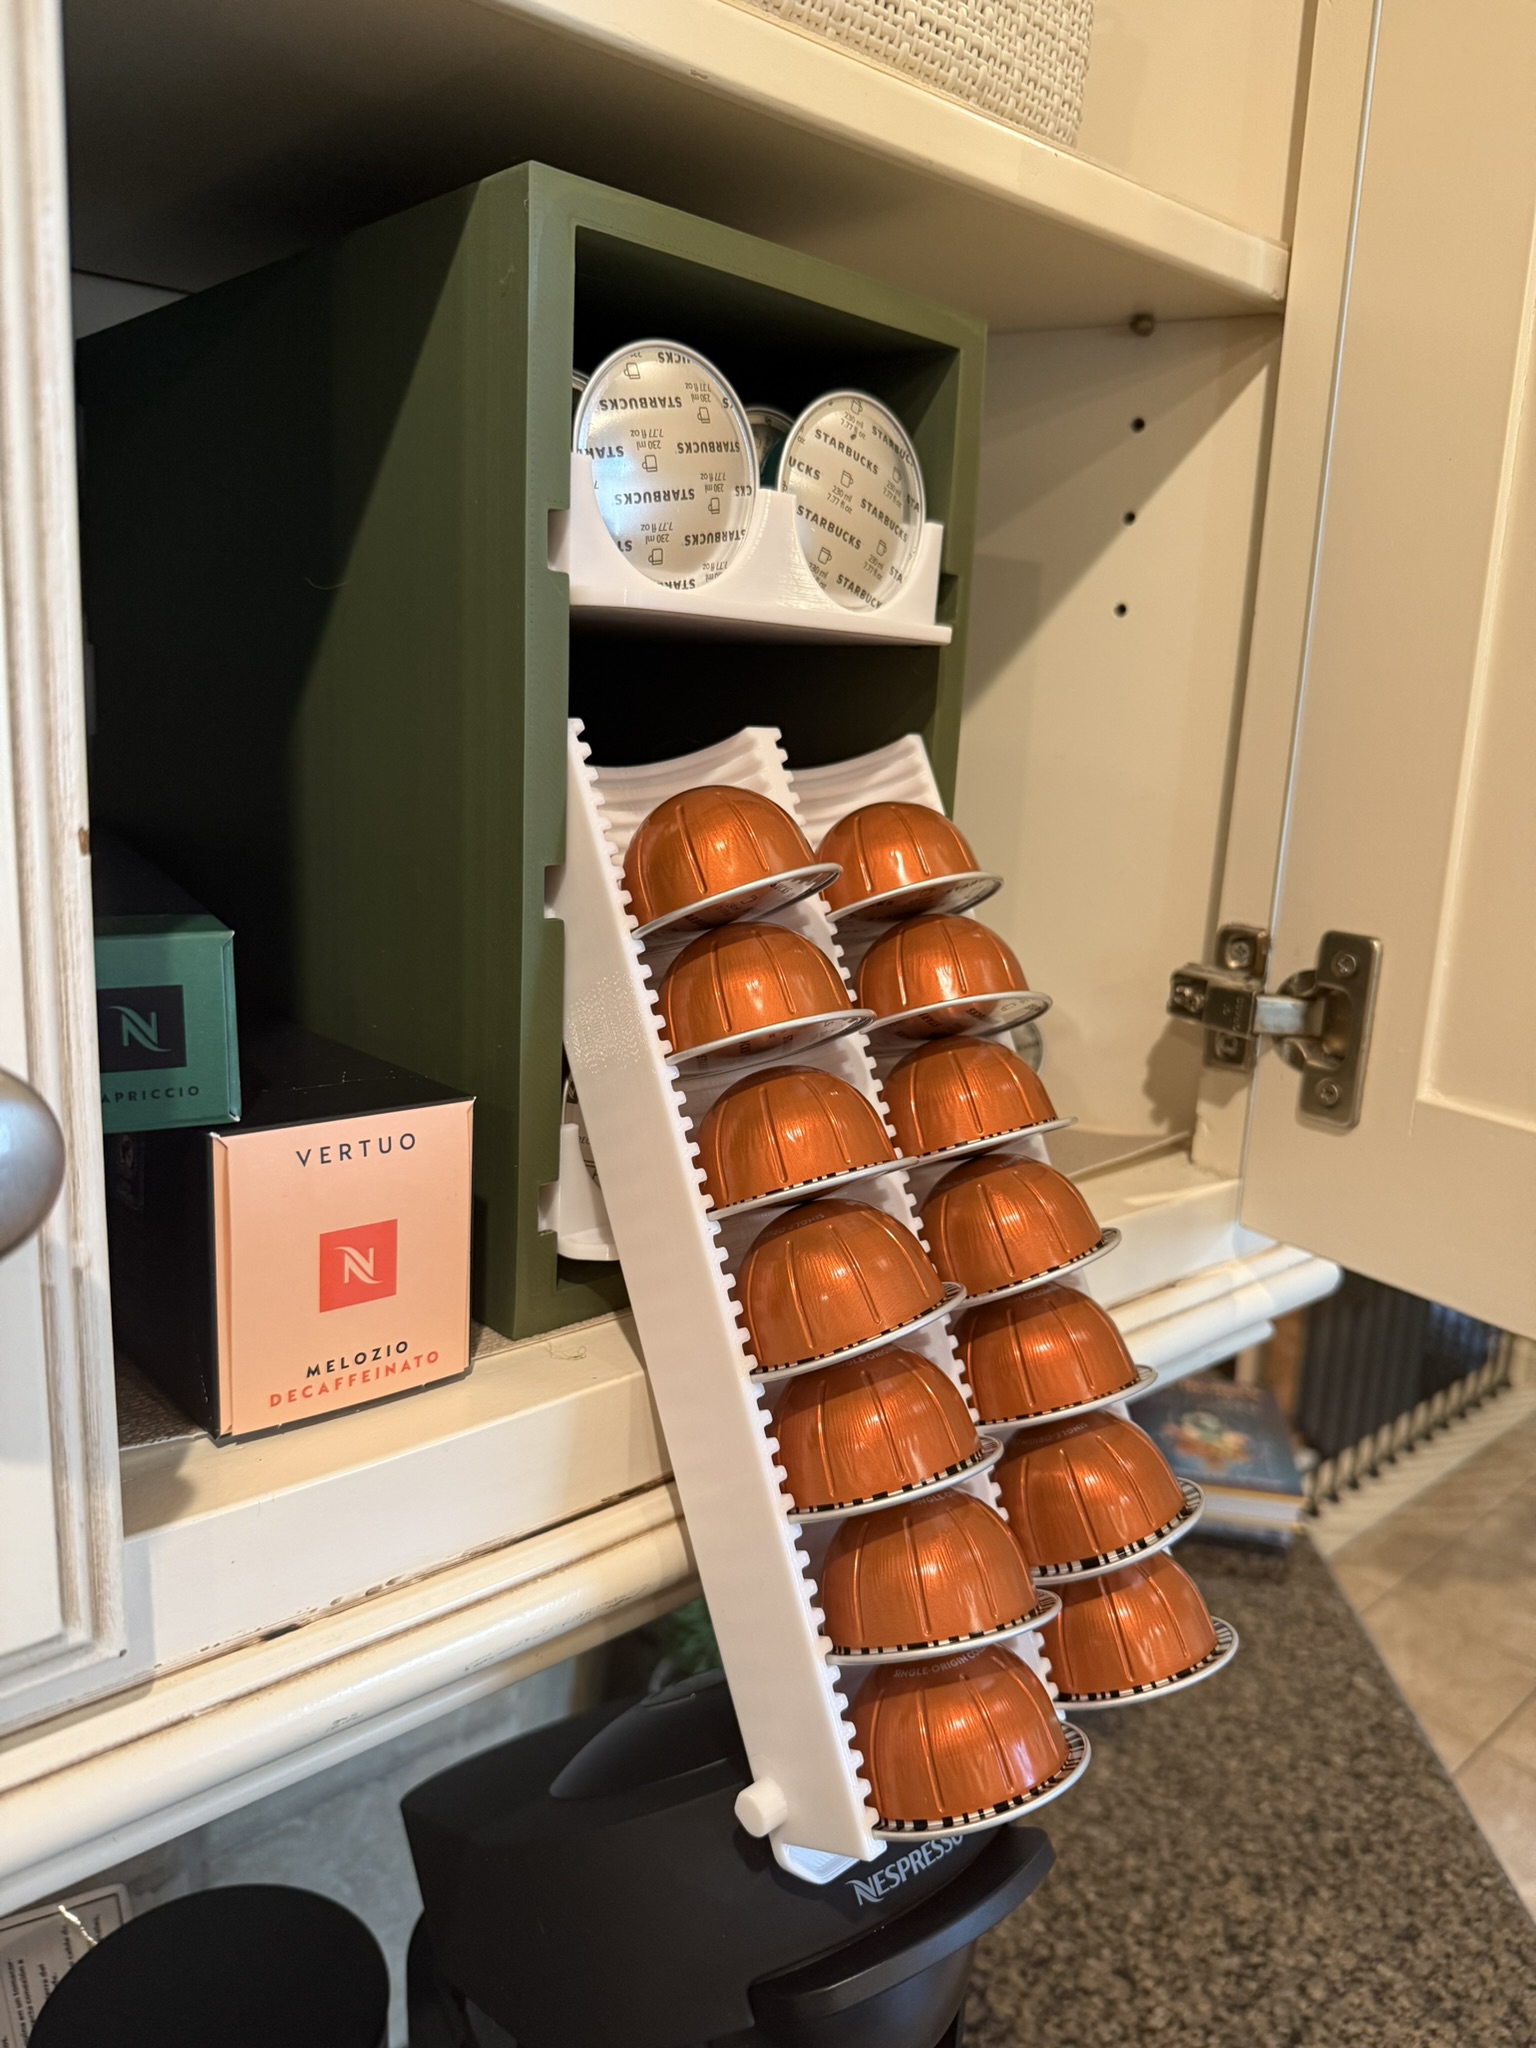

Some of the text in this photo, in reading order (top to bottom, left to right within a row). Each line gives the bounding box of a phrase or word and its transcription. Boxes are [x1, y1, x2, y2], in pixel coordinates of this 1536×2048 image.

[599, 396, 682, 410] STARBUCKS
[630, 429, 640, 437] oz
[648, 428, 664, 438] 7.77
[636, 440, 662, 450] 230 ml
[677, 441, 740, 454] STARBUCKS
[814, 428, 879, 475] STARBUCKS
[871, 425, 913, 467] STARBUC
[715, 472, 726, 481] 7.77
[614, 488, 695, 505] STARBUCKS
[704, 483, 724, 493] 230 ml
[832, 485, 852, 503] 230 ml
[826, 492, 840, 506] 7.77
[844, 505, 853, 515] oz
[658, 522, 674, 532] 7.77
[796, 505, 861, 550] STARBUCKS
[860, 498, 908, 543] STARBUCKS
[645, 533, 670, 545] 230 ml
[684, 529, 746, 547] STARBUCKS
[296, 1132, 417, 1167] VERTUO
[305, 1340, 409, 1379] MELOZIO
[268, 1350, 440, 1408] DECAFFEINATO
[894, 1655, 968, 1678] SINGLE-ORIGIN
